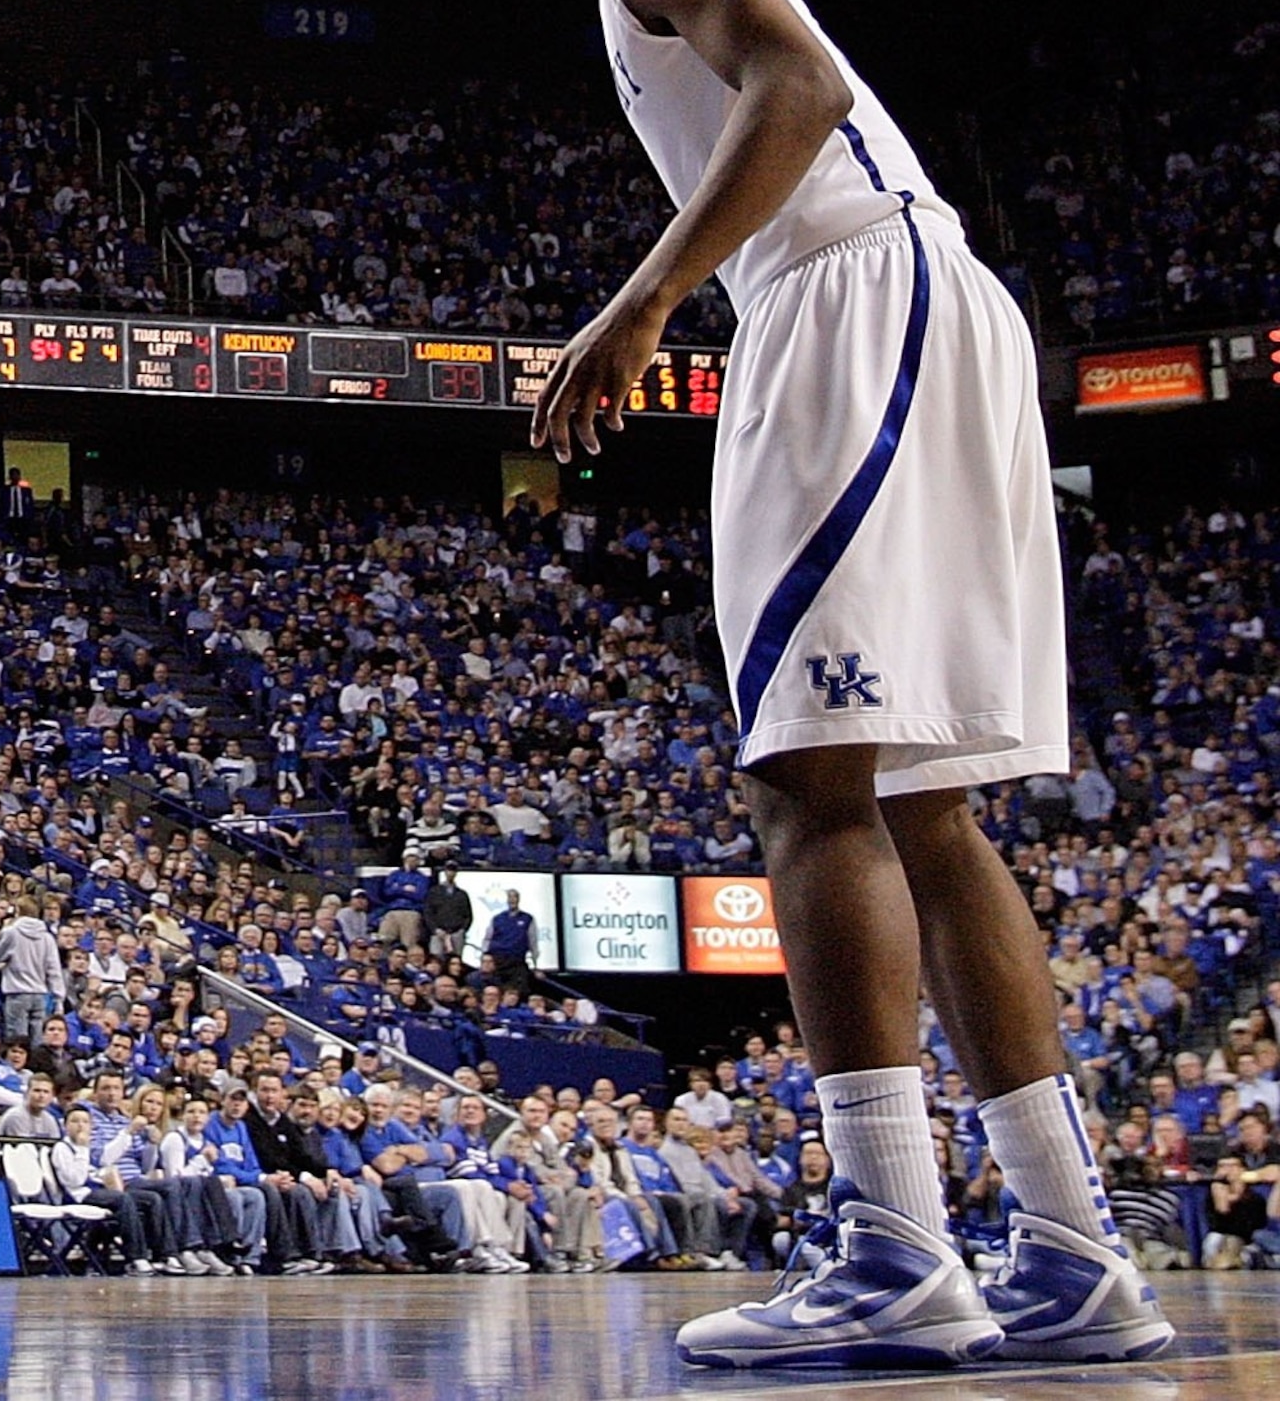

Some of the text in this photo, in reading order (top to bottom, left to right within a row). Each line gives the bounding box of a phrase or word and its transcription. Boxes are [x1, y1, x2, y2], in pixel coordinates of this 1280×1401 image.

[293, 7, 349, 35] 219
[34, 323, 115, 341] PLY FLS PTS
[133, 328, 193, 345] TIME OUTS
[222, 332, 296, 354] KENTUCKY
[1, 336, 17, 358] 7
[29, 337, 118, 363] 54 2 4
[147, 343, 178, 356] LEFT
[507, 345, 563, 361] TIME OUT
[0, 361, 17, 381] 4
[138, 360, 172, 374] TEAM
[522, 359, 550, 374] LEFT
[690, 353, 713, 368] PLY
[136, 373, 175, 388] FOULS
[194, 363, 212, 390] 0
[439, 364, 482, 399] 39
[658, 367, 675, 390] 5
[688, 368, 719, 390] 21
[1117, 361, 1196, 384] TOYOTA
[329, 378, 388, 398] PERIOD 2
[512, 390, 541, 404] FOU
[659, 391, 677, 412] 9
[688, 391, 719, 415] 22
[276, 453, 305, 476] 19
[805, 652, 883, 709] UK
[571, 905, 669, 935] Lexington
[596, 936, 648, 961] Clinic
